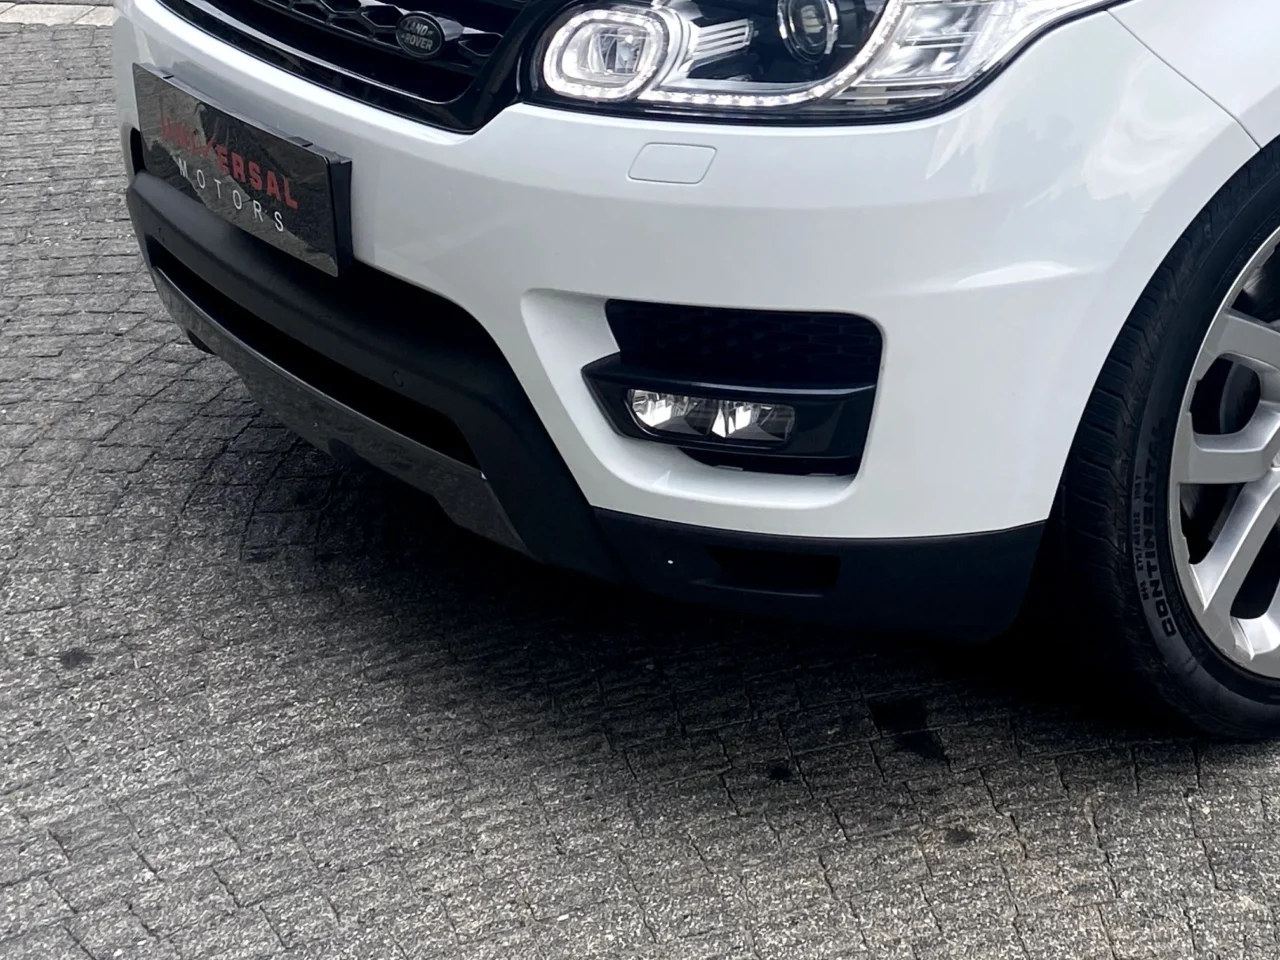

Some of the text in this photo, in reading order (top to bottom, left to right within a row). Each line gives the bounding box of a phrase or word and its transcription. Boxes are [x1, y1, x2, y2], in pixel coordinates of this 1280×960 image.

[404, 19, 429, 36] LAND
[404, 33, 433, 50] ROVER
[178, 157, 284, 232] MOTORS
[1142, 416, 1177, 638] CONTINENTAL
